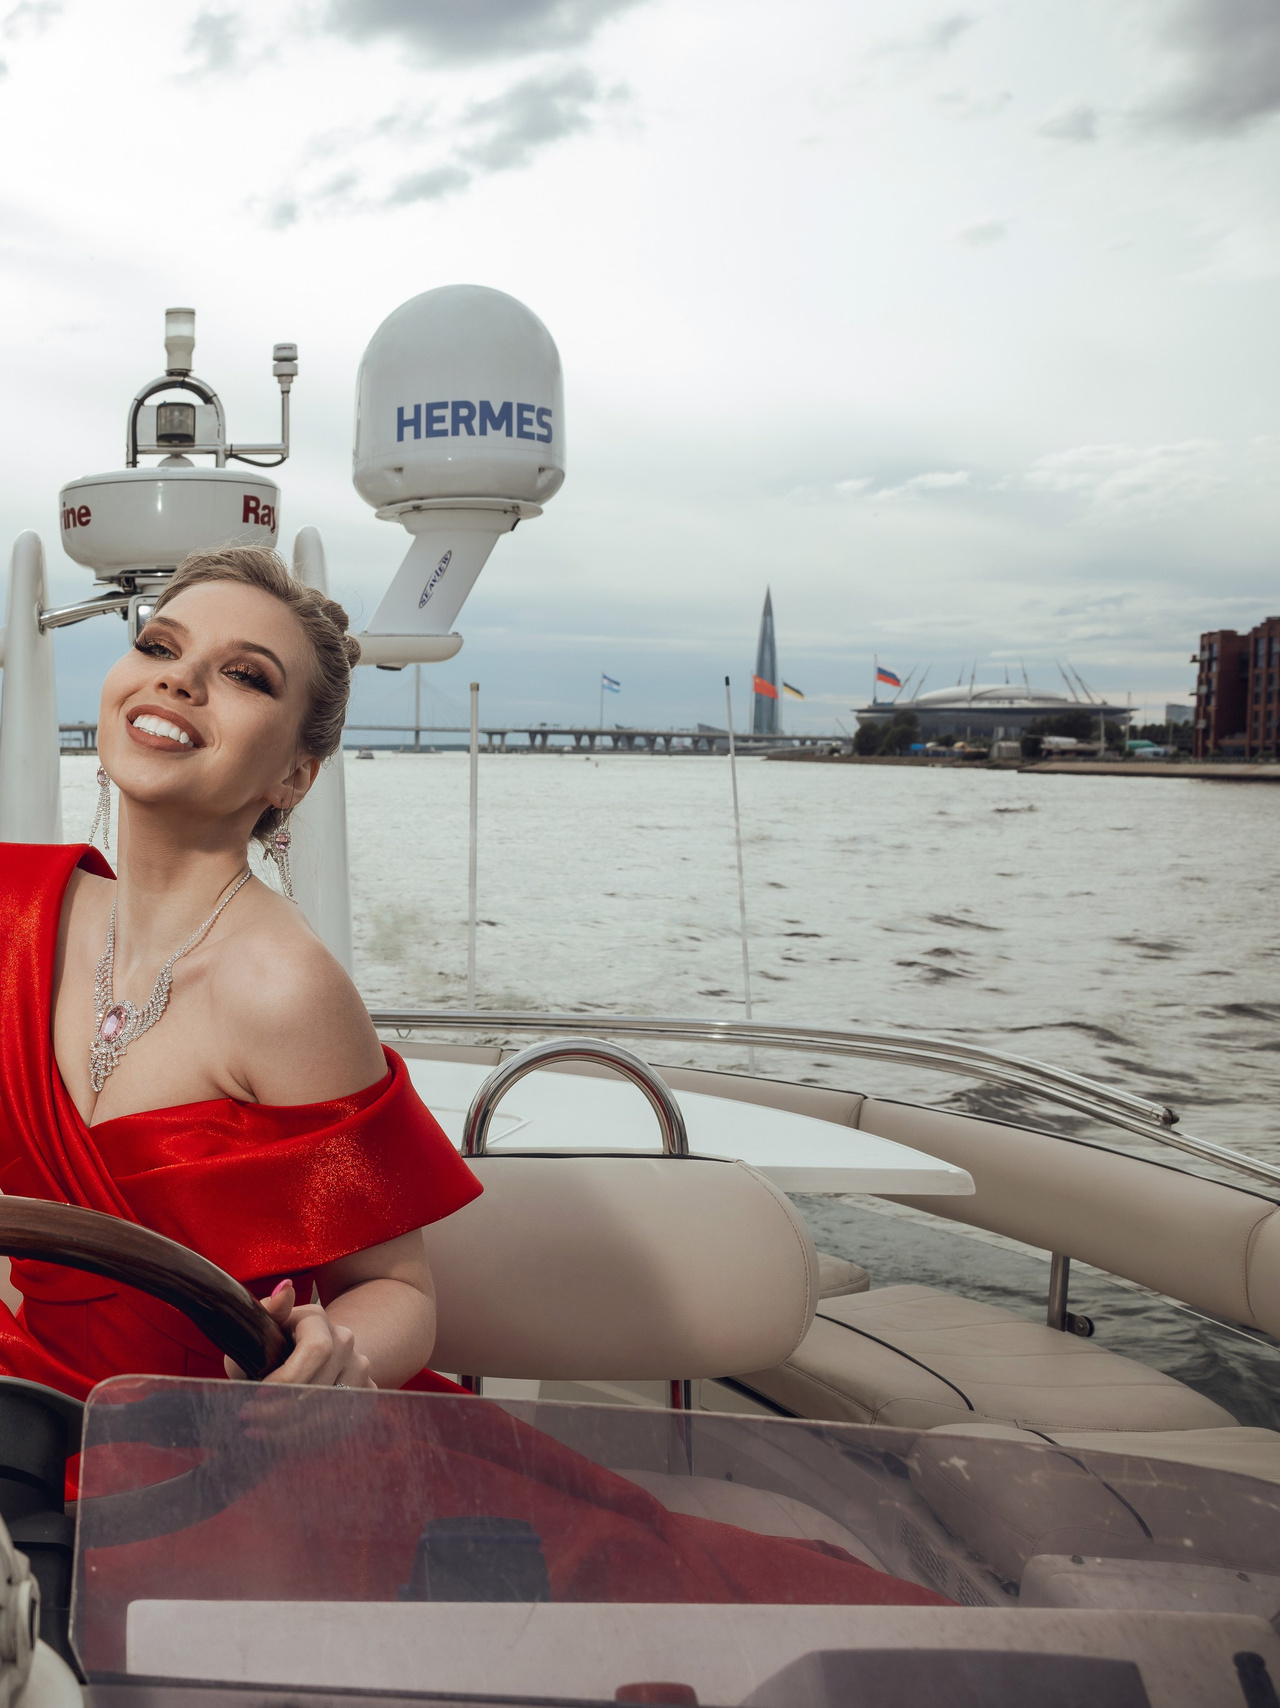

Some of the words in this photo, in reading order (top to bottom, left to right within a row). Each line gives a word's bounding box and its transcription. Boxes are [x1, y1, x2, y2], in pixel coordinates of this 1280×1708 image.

[395, 400, 553, 444] HERMES
[62, 501, 92, 530] ine
[420, 553, 449, 606] SEAVIEW
